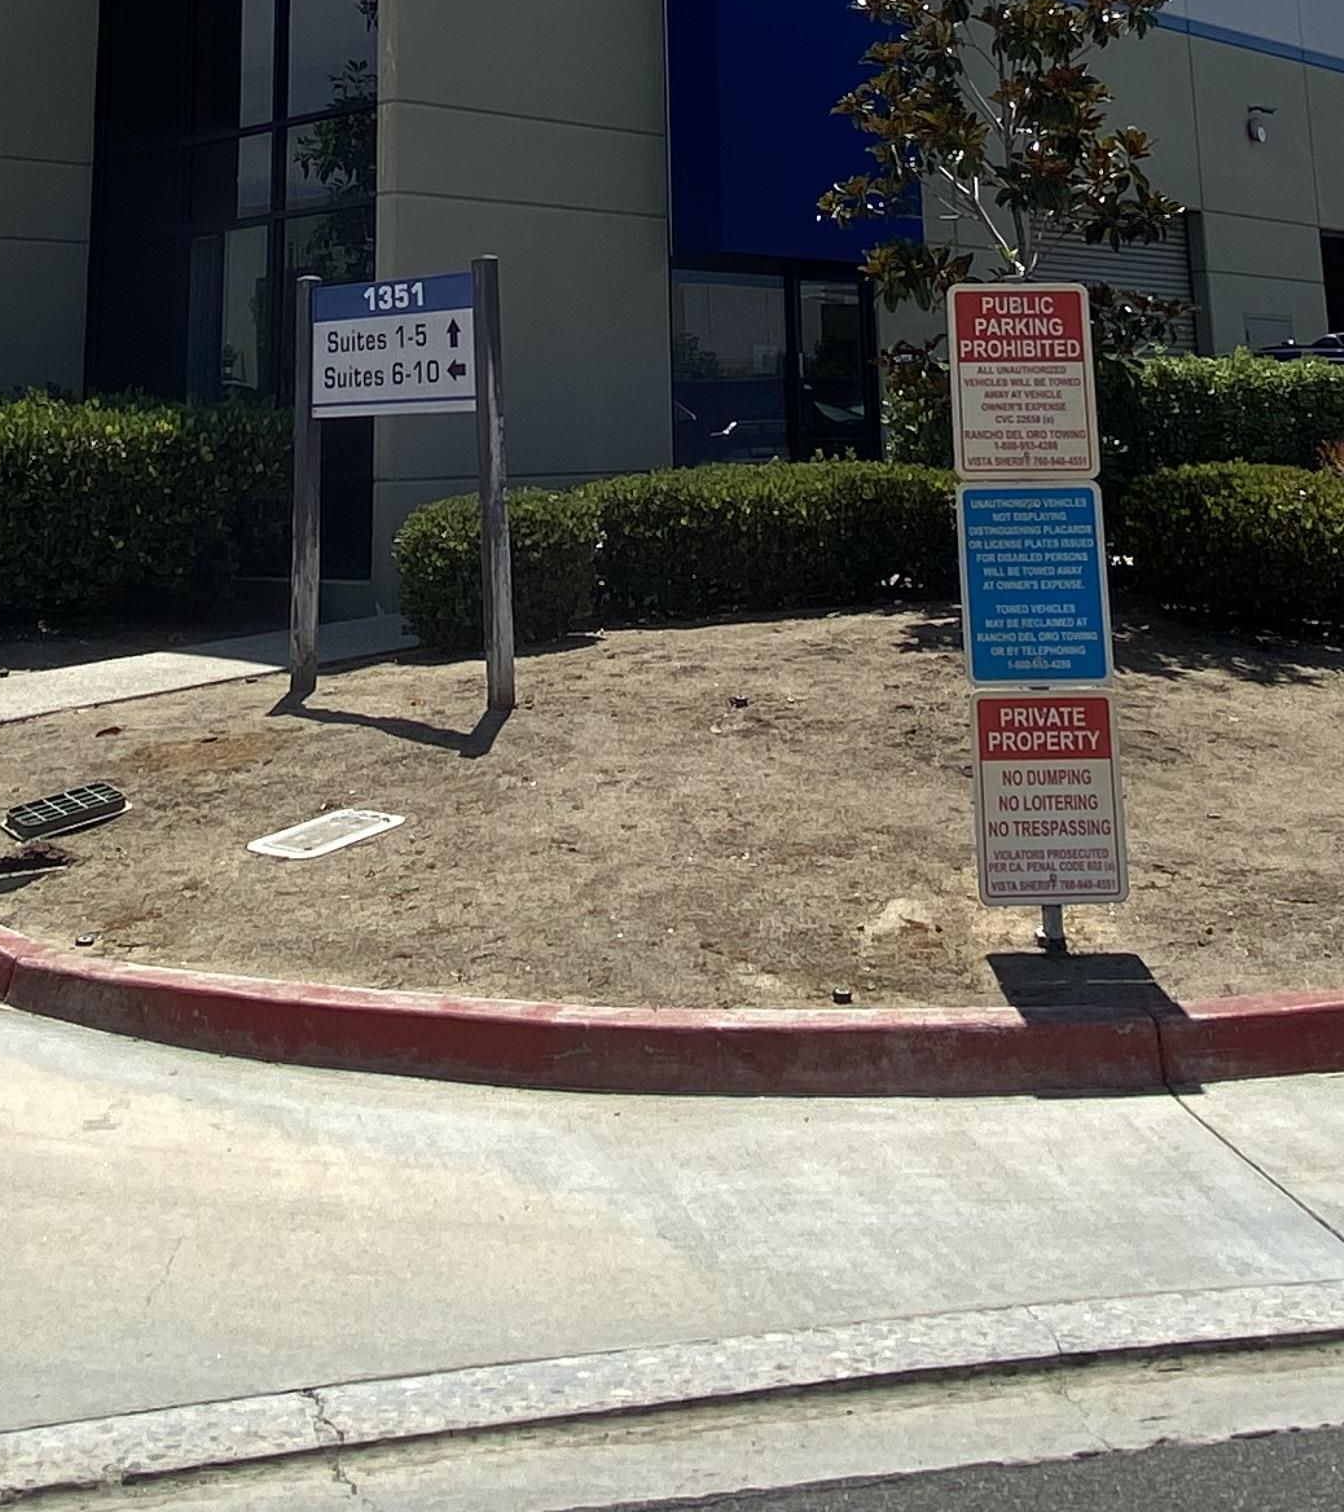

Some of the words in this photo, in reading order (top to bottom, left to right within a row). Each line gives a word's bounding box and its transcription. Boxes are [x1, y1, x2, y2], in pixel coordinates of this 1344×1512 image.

[363, 282, 425, 312] 1351
[982, 296, 1054, 314] PUBLIC
[975, 318, 1064, 336] PARKING
[327, 331, 387, 353] Suites
[395, 324, 427, 348] 1-5
[960, 340, 1081, 358] PROHIBITED
[324, 366, 384, 389] Suites
[392, 360, 440, 385] 6-10
[977, 366, 994, 374] ALL
[964, 378, 1008, 386] VEHICLES
[1000, 707, 1087, 728] PRIVATE
[988, 731, 1100, 752] PROPERTY
[1002, 771, 1023, 786] NO
[1027, 769, 1092, 786] DUMPING
[999, 796, 1020, 812] NO
[1023, 794, 1098, 811] LOITERING
[988, 822, 1009, 837] NO
[1013, 819, 1112, 837] TRESPASSING
[994, 850, 1045, 860] VIOLATORS
[1047, 848, 1109, 859] PROSECUTED
[1027, 862, 1057, 871] PENAL
[1059, 861, 1084, 871] CODE
